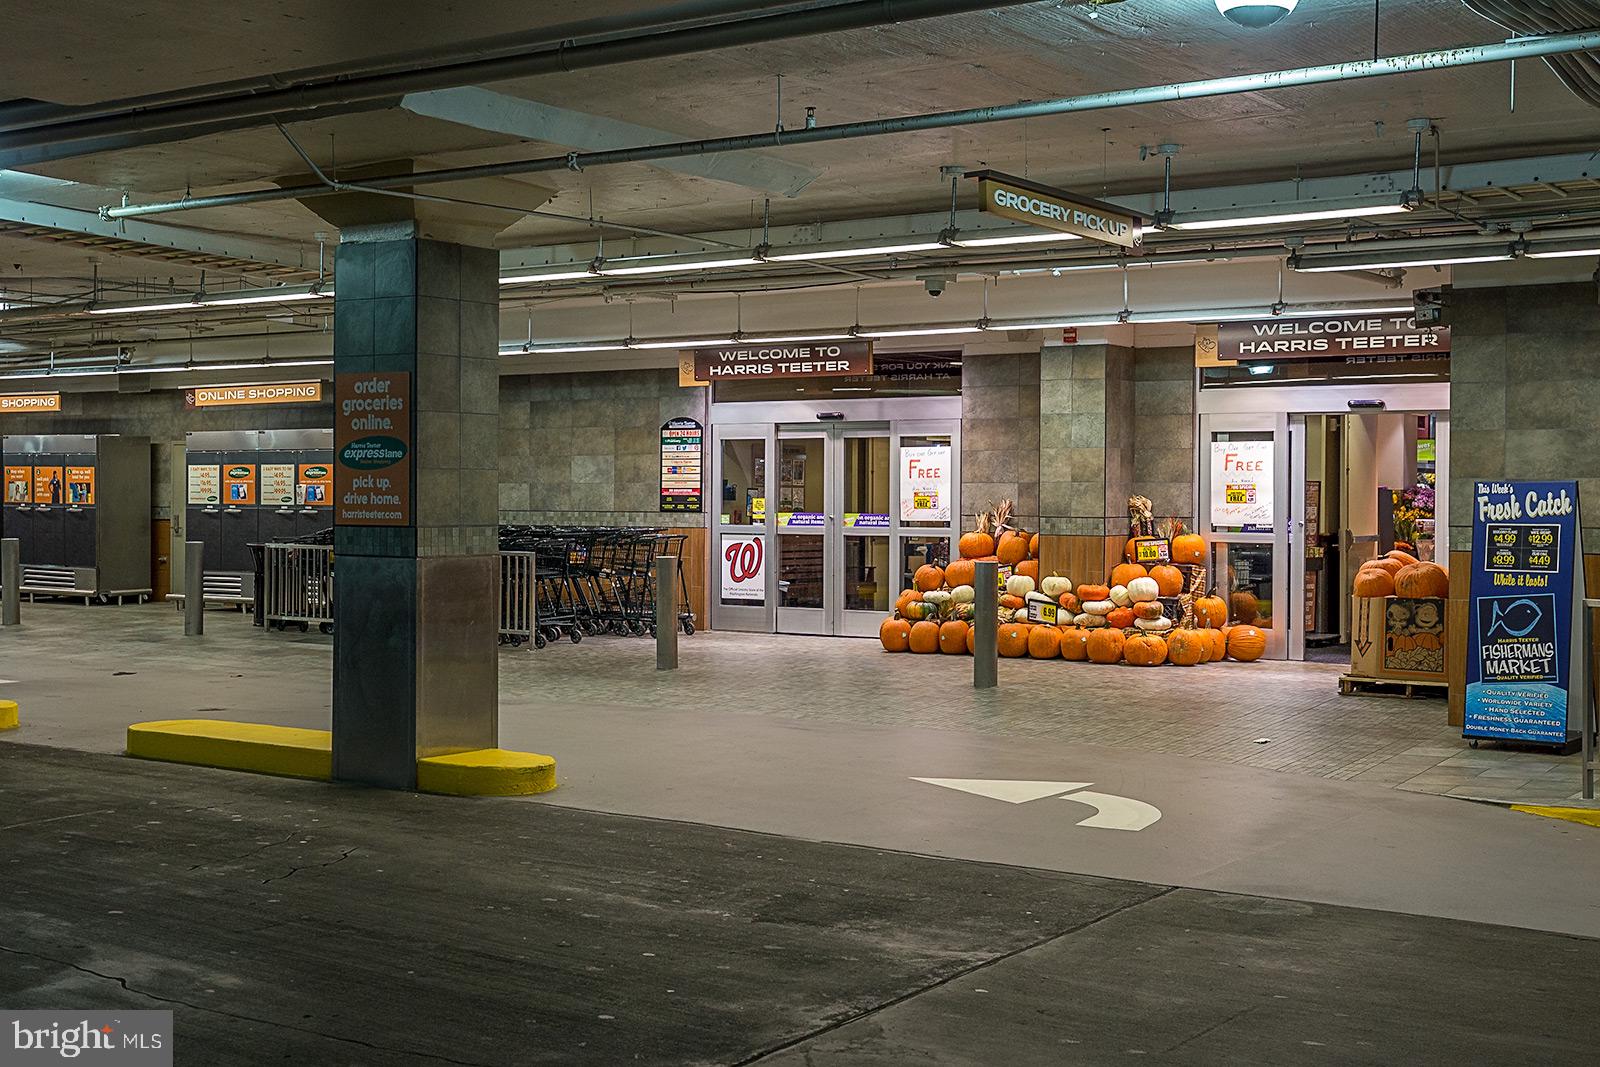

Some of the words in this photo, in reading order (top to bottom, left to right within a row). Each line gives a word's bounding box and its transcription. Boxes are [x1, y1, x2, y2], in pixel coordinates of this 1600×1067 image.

[994, 189, 1071, 222] GROCERY
[1073, 210, 1107, 232] PICK
[1106, 220, 1129, 237] UP
[1252, 319, 1382, 337] WELCOME
[1238, 337, 1329, 354] HARRIS
[1334, 333, 1439, 350] TEETER
[718, 347, 811, 362] WELCOME
[814, 346, 841, 358] TO
[709, 363, 774, 377] HARRIS
[777, 360, 850, 374] TEETER
[353, 377, 391, 394] order
[198, 388, 245, 402] ONLINE
[248, 386, 316, 400] SHOPPING
[1, 397, 56, 409] SHOPPING
[342, 395, 403, 416] groceries
[351, 414, 394, 431] online.
[352, 474, 374, 491] pick
[376, 477, 392, 491] up.
[1477, 483, 1491, 495] This
[1491, 483, 1514, 494] Week's
[343, 491, 368, 505] drive
[370, 492, 401, 505] home.
[1477, 494, 1523, 522] Fresh
[1525, 489, 1573, 519] Catch
[341, 508, 403, 520] harristeeter.com
[1493, 533, 1517, 544] $4.99
[1528, 533, 1554, 545] $12.99
[725, 536, 763, 583] W
[1493, 572, 1517, 587] While
[1517, 573, 1525, 587] it
[1525, 574, 1549, 588] lasts!
[1043, 607, 1055, 618] 6.99
[1482, 641, 1555, 660] FISHERMANS
[1486, 656, 1552, 676] MARKET
[1486, 689, 1516, 697] QUALITY
[1516, 691, 1549, 699] VERIFIED
[1480, 697, 1522, 706] WORLDWIDE
[1523, 700, 1553, 708] VARIETY
[1488, 706, 1509, 714] HAND
[1509, 708, 1546, 717] SELECTED
[1473, 713, 1513, 723] FRESHNESS
[1513, 716, 1561, 727] GUARANTEED
